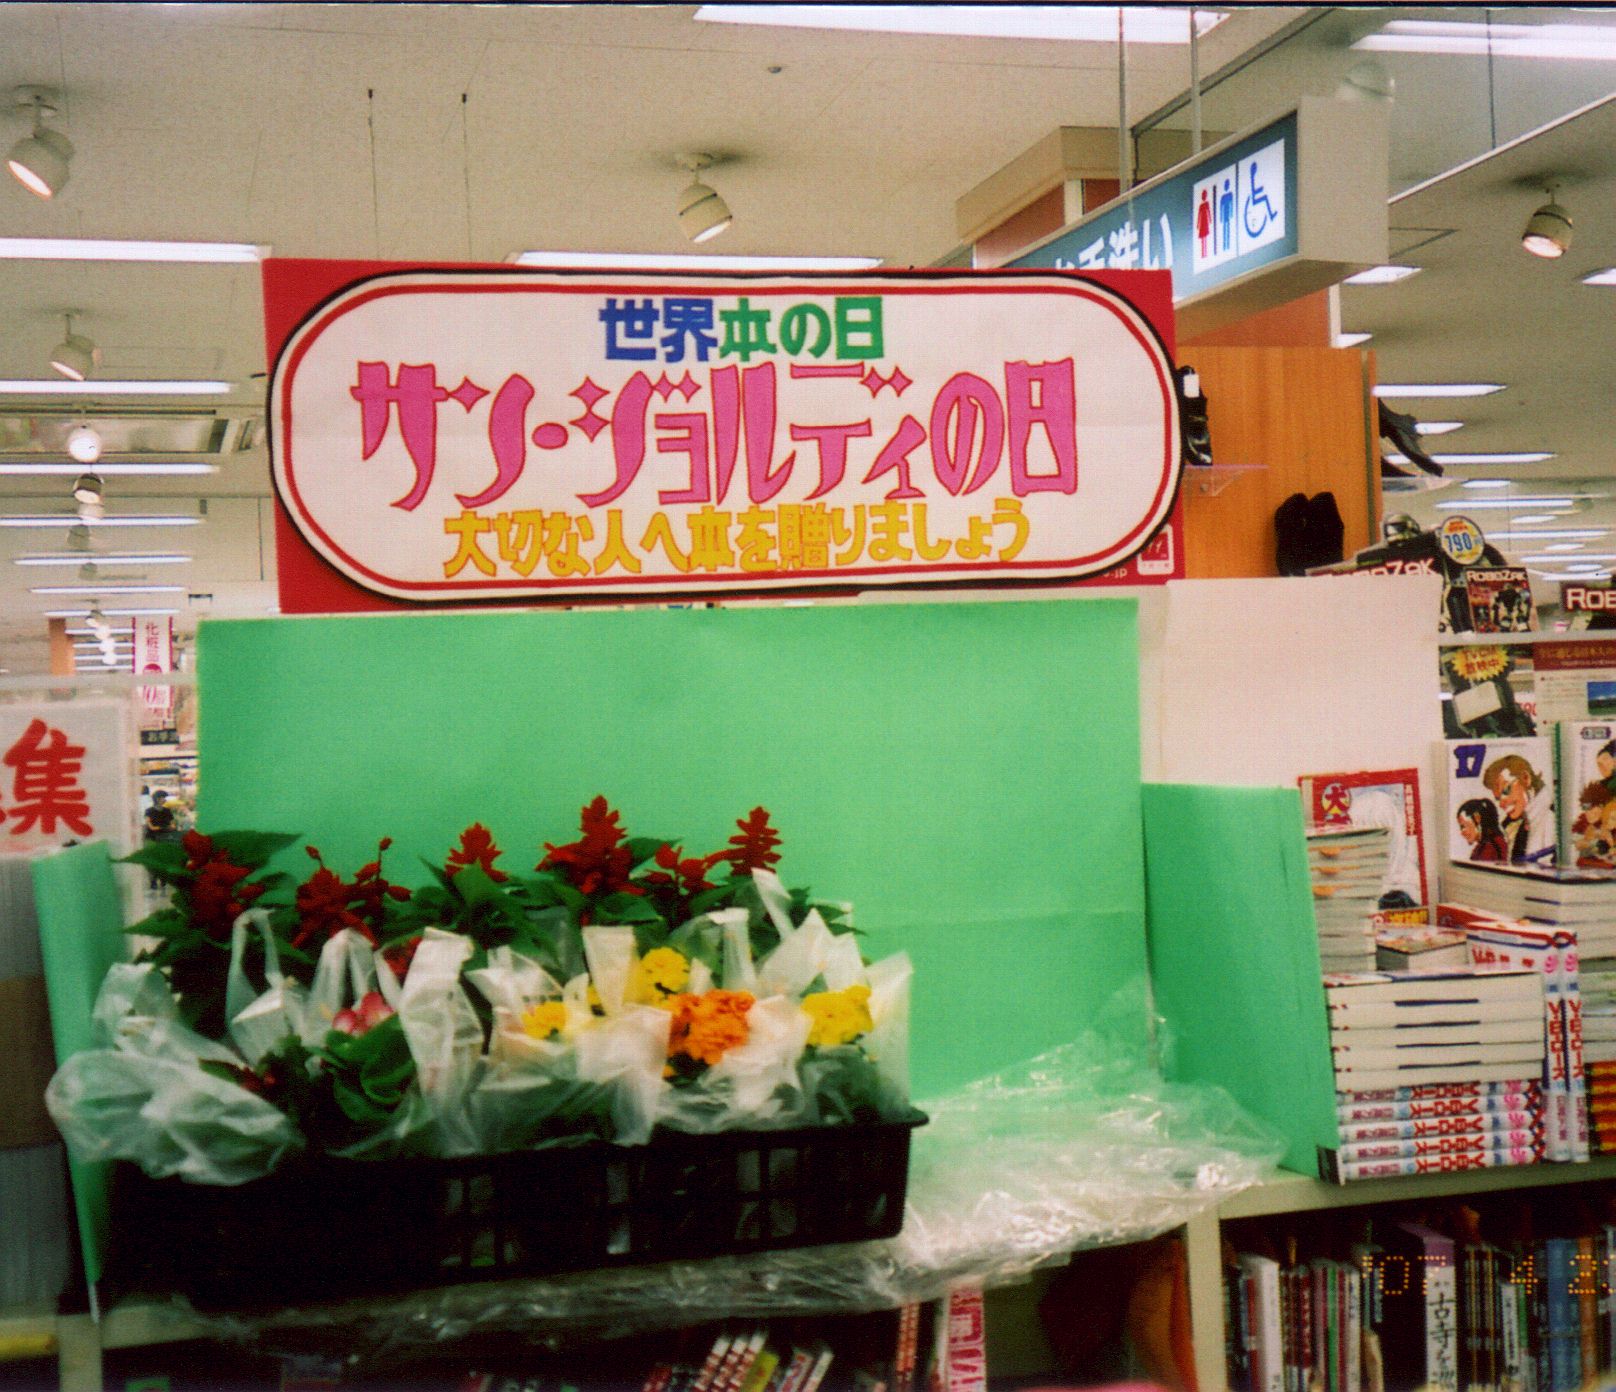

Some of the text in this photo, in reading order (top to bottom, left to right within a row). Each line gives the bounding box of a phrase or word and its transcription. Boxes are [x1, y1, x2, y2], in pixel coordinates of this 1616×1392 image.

[1056, 213, 1173, 270] 手洗い
[598, 293, 884, 362] 世界本の日
[443, 497, 1031, 578] 大切な人へ本を贈りましょう
[0, 718, 93, 837] 集
